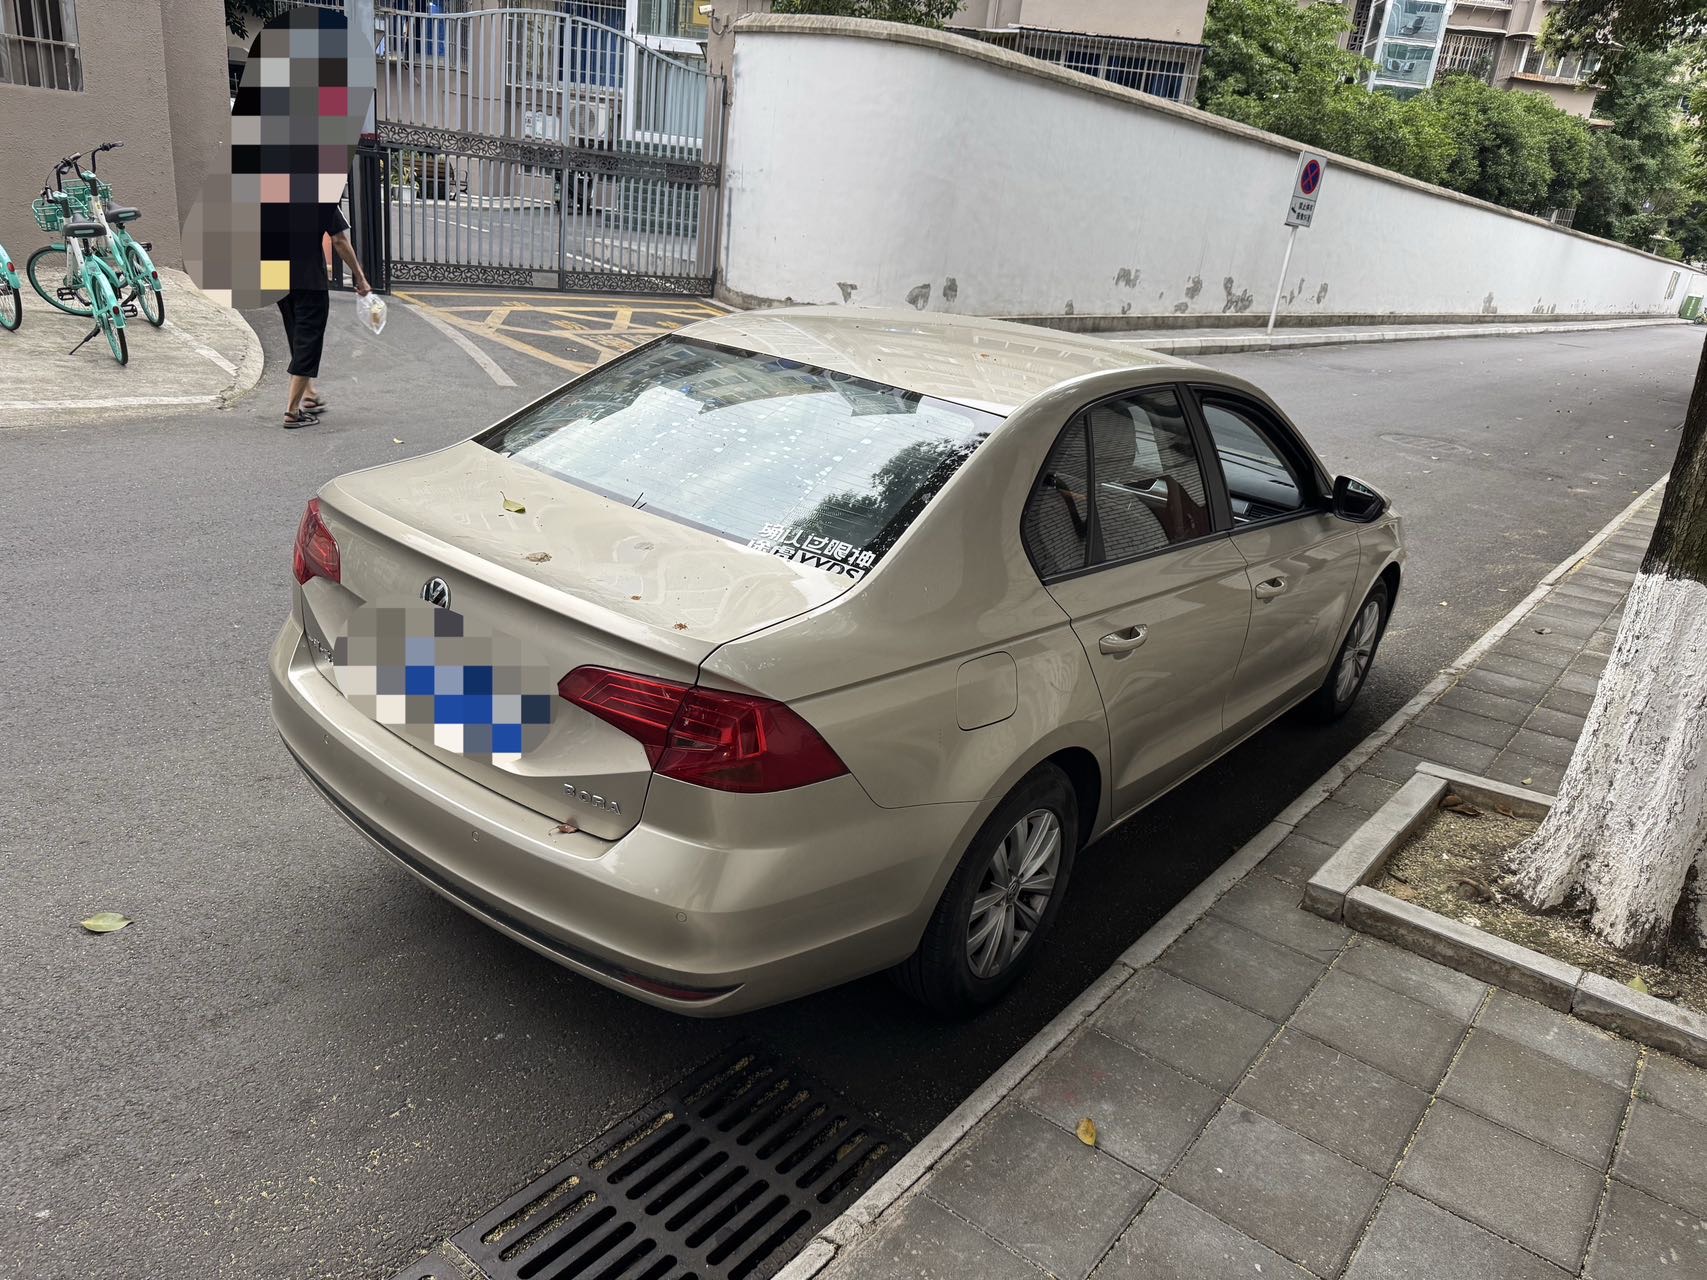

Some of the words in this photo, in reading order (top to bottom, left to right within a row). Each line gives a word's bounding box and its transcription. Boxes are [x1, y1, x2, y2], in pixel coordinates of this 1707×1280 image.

[758, 522, 877, 568] 确认过眼神
[563, 783, 622, 816] BORA
